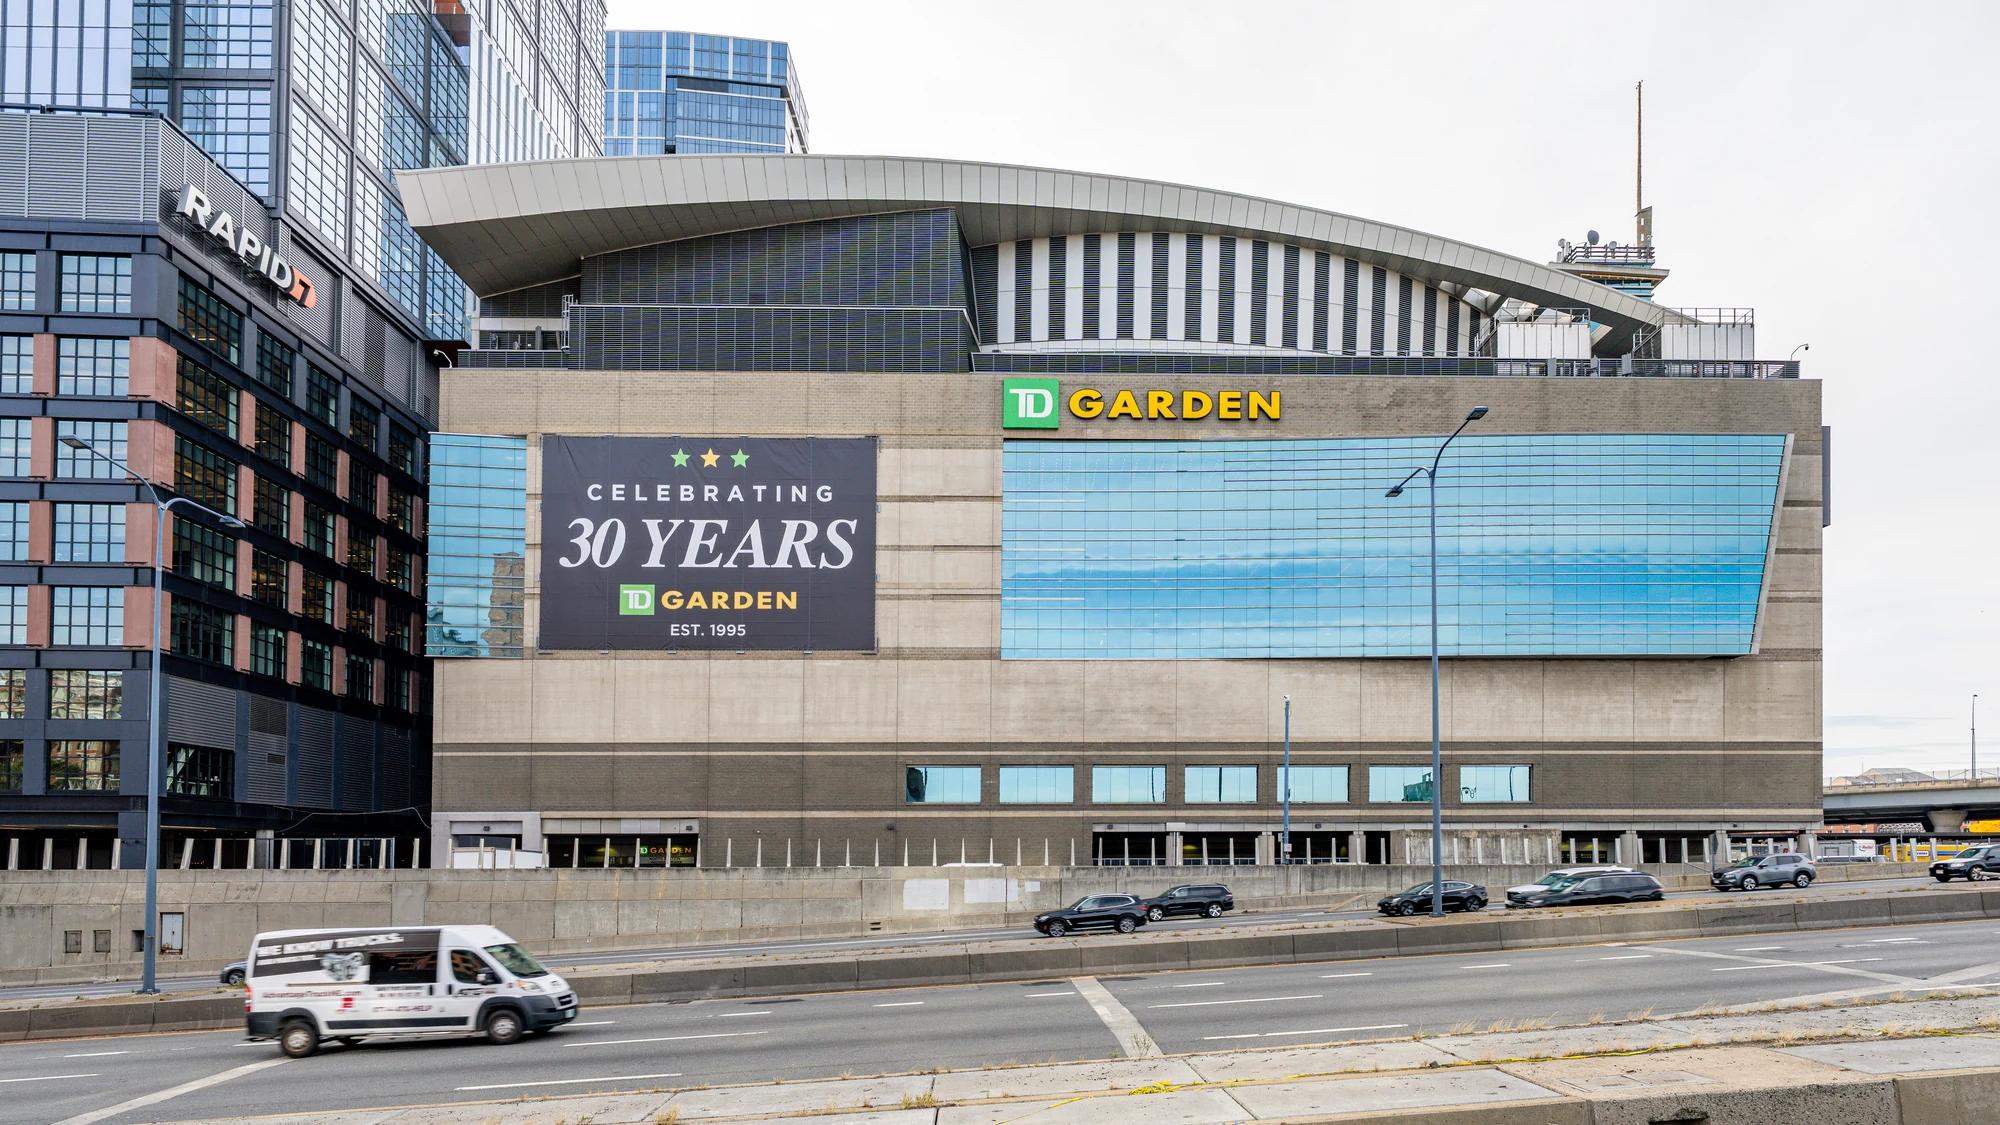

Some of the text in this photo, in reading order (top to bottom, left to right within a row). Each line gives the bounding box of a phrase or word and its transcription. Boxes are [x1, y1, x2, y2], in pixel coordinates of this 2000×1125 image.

[178, 184, 317, 309] RAPID7
[1008, 388, 1281, 420] TD GARDEN
[586, 484, 833, 502] CELEBRATING
[558, 517, 858, 569] 30 YEARS
[622, 589, 798, 610] TD GARDEN
[670, 624, 746, 636] EST. 1995
